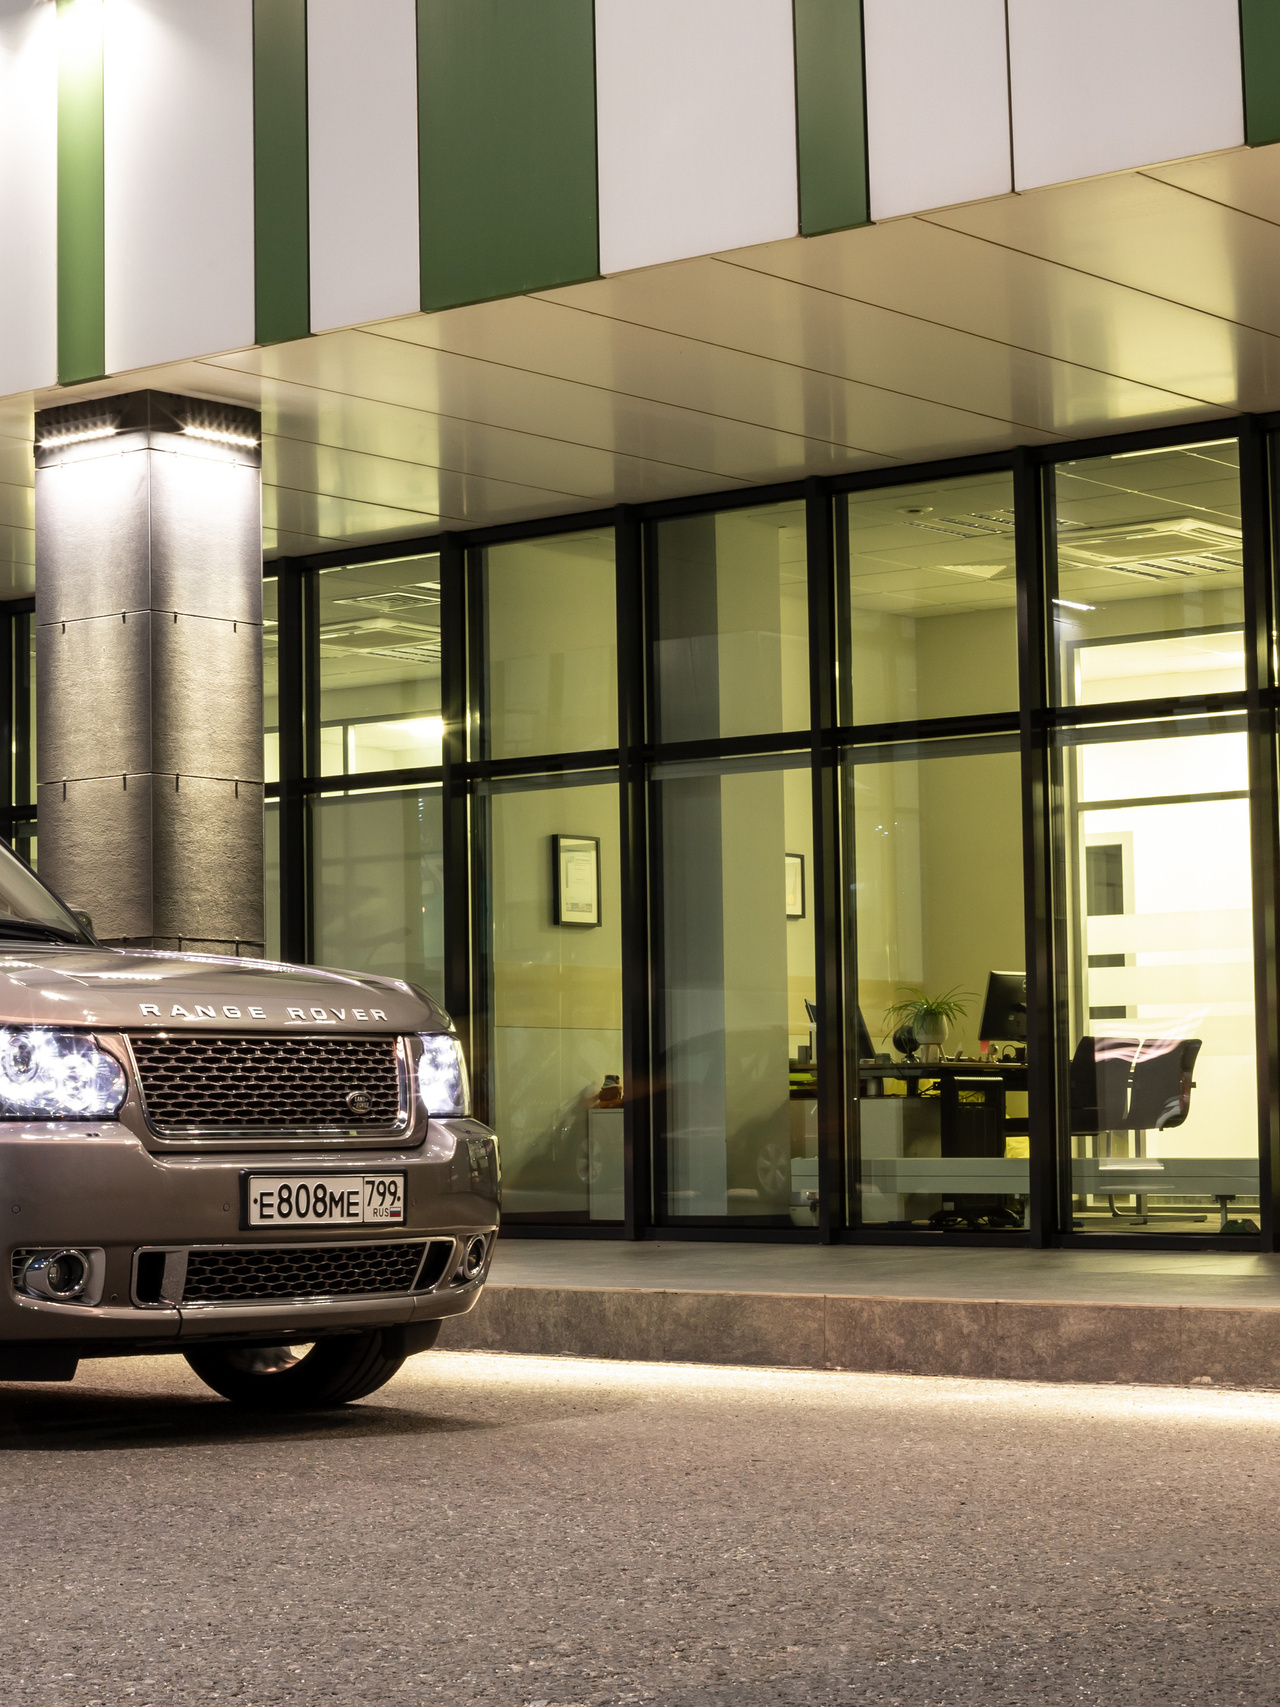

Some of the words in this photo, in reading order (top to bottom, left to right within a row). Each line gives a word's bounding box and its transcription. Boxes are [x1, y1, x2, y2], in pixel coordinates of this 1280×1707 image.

[138, 1003, 267, 1019] RANGE
[286, 1007, 388, 1021] ROVER
[259, 1182, 359, 1219] E808ME
[365, 1179, 398, 1207] 799
[372, 1207, 390, 1218] RUS
